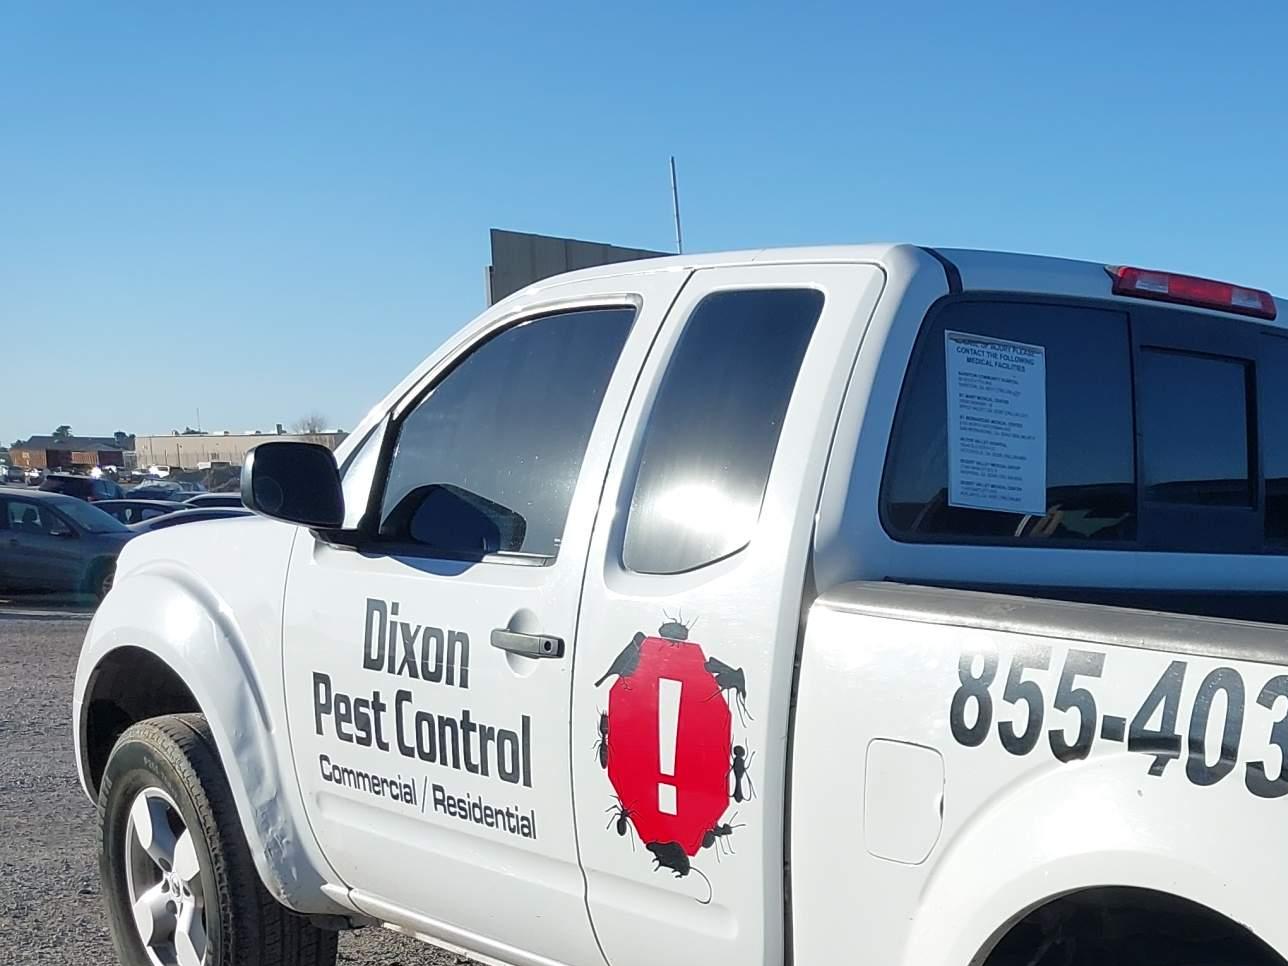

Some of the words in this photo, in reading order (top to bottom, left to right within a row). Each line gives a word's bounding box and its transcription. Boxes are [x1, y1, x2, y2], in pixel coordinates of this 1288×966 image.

[956, 346, 985, 358] CONTACT
[986, 350, 999, 359] THE
[1000, 353, 1035, 366] FOLLOWING
[966, 357, 995, 367] MEDICAL
[363, 598, 470, 689] Dixon
[312, 671, 391, 752] Pest
[395, 690, 533, 788] Control
[319, 754, 417, 807] Commercial
[433, 784, 537, 840] Residential
